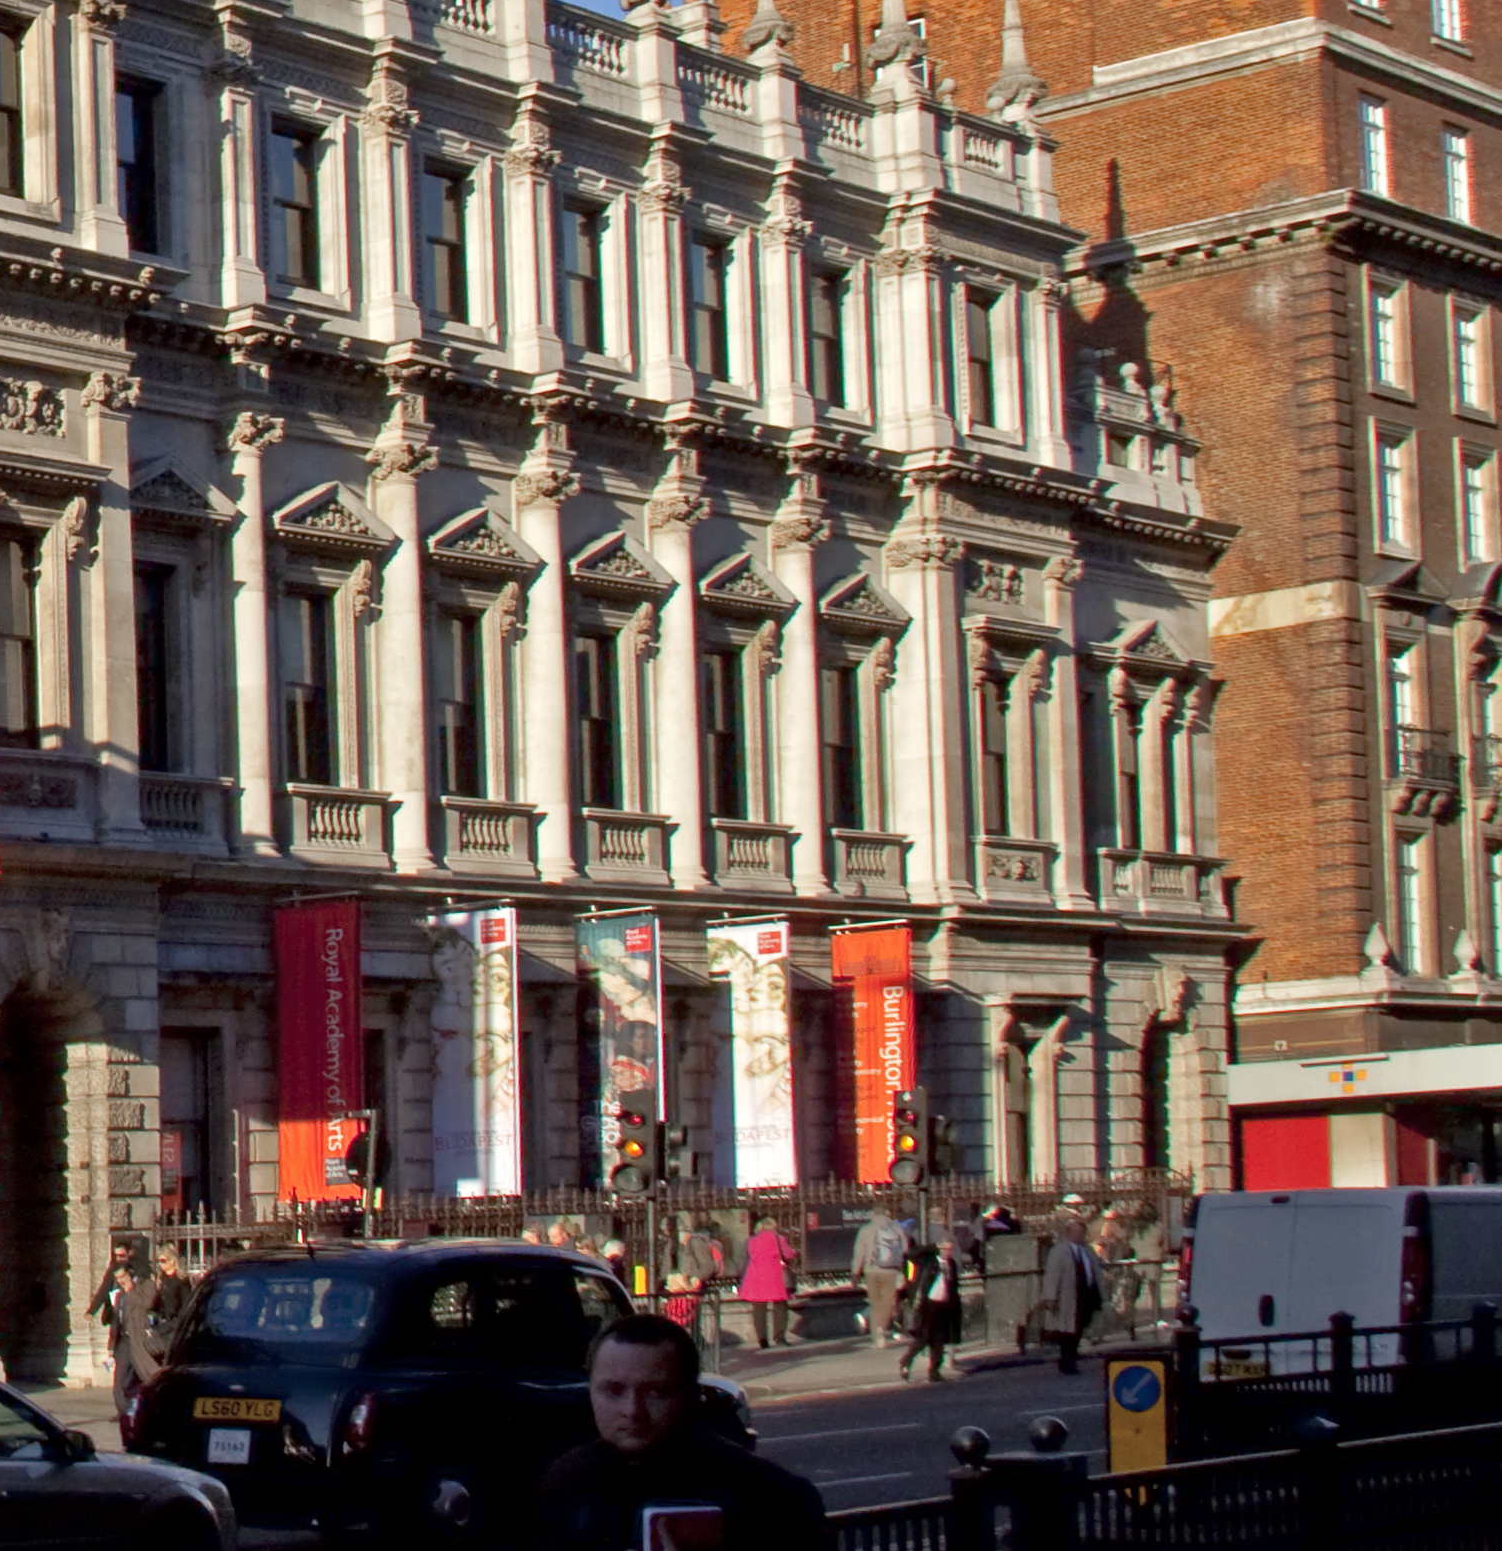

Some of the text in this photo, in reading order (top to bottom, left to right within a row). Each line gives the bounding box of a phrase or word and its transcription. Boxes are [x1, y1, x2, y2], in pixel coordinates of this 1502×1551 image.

[320, 928, 346, 1152] Royal Academy of Arts
[435, 1134, 513, 1151] BUDAPEST
[201, 1400, 274, 1417] LS60 YLG
